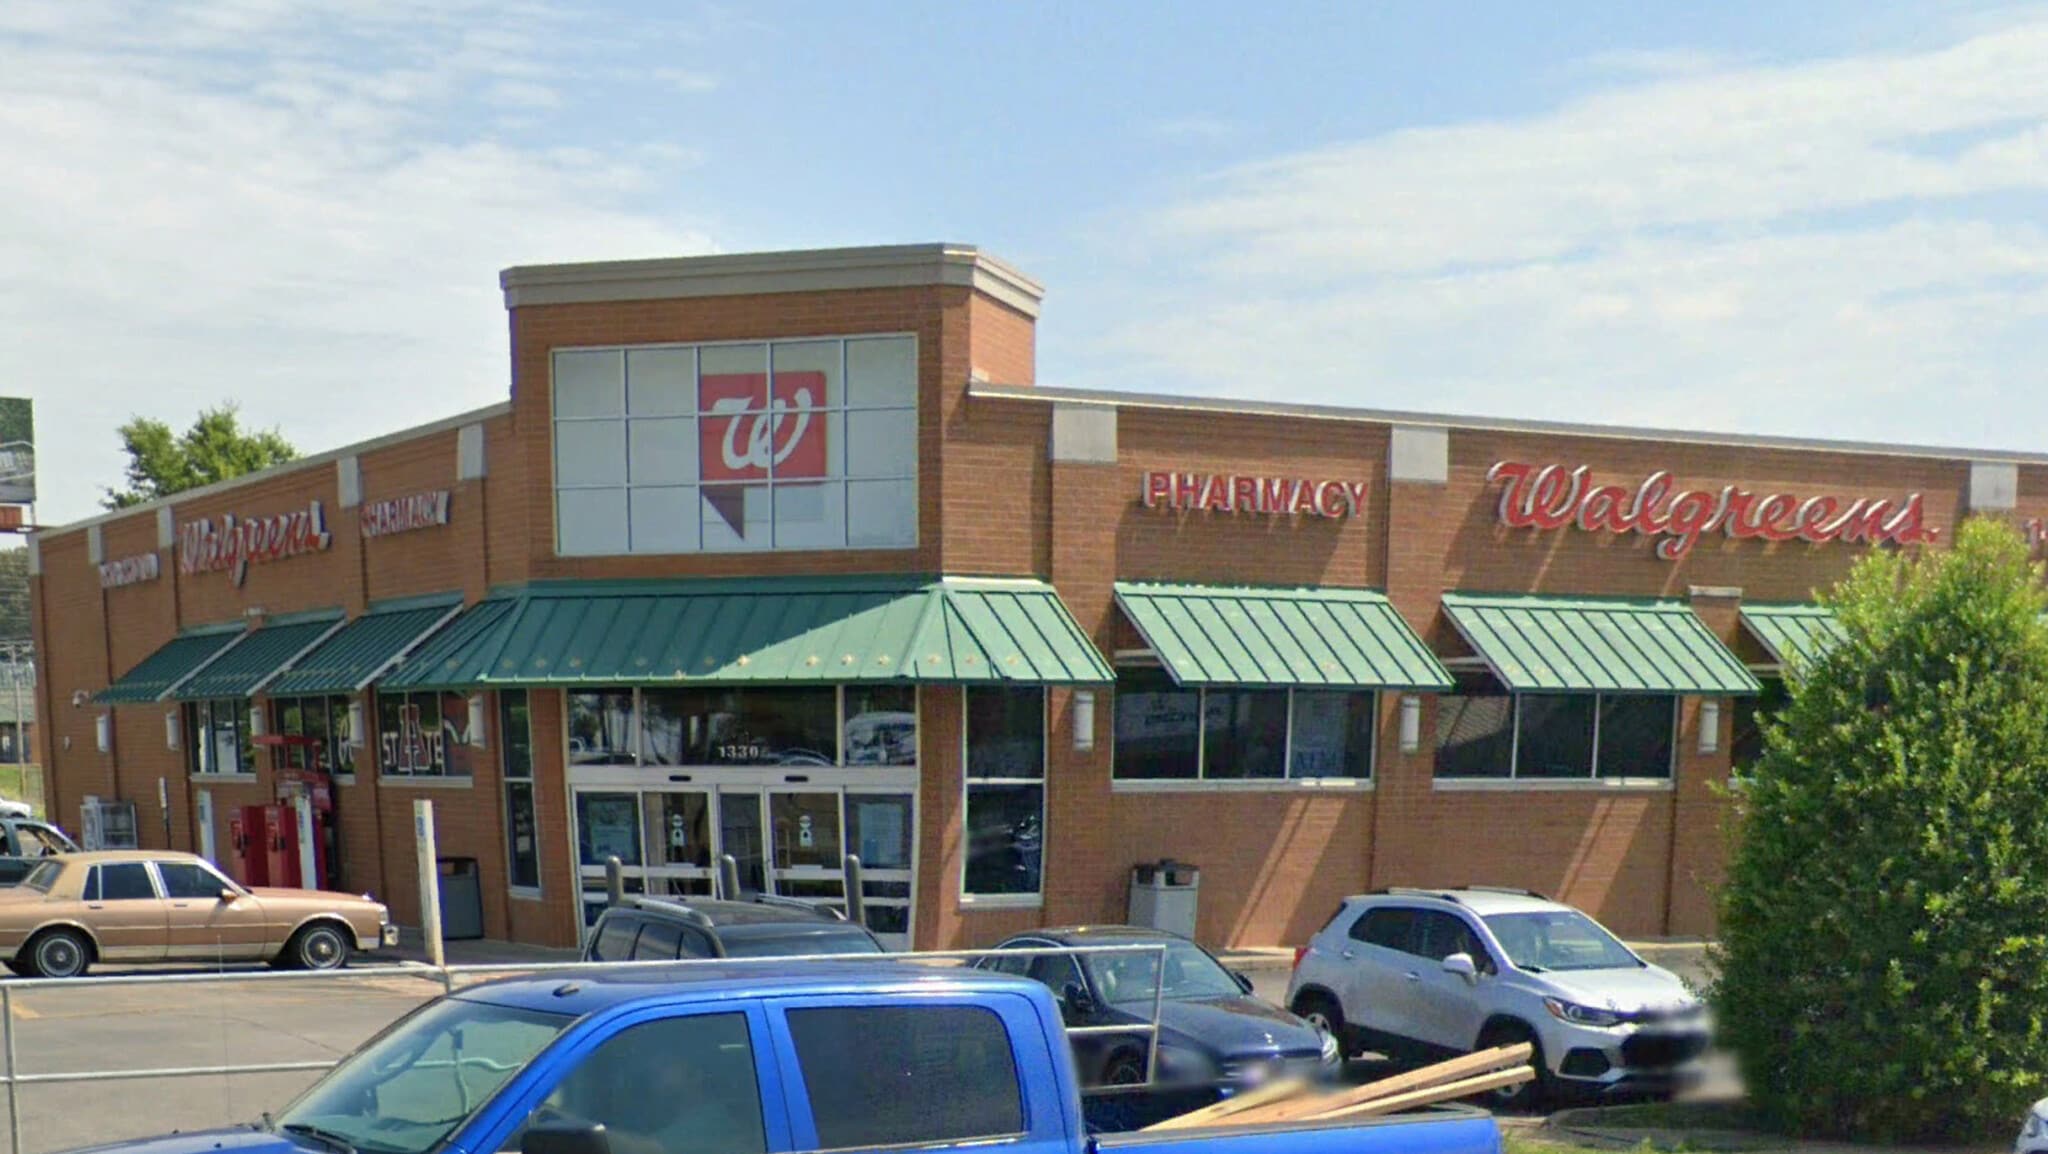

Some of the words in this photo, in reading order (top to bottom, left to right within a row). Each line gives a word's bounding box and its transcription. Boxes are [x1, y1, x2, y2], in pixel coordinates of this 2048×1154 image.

[712, 387, 812, 470] W
[1143, 471, 1369, 518] PHARMACY
[1487, 460, 1940, 560] Walgreens
